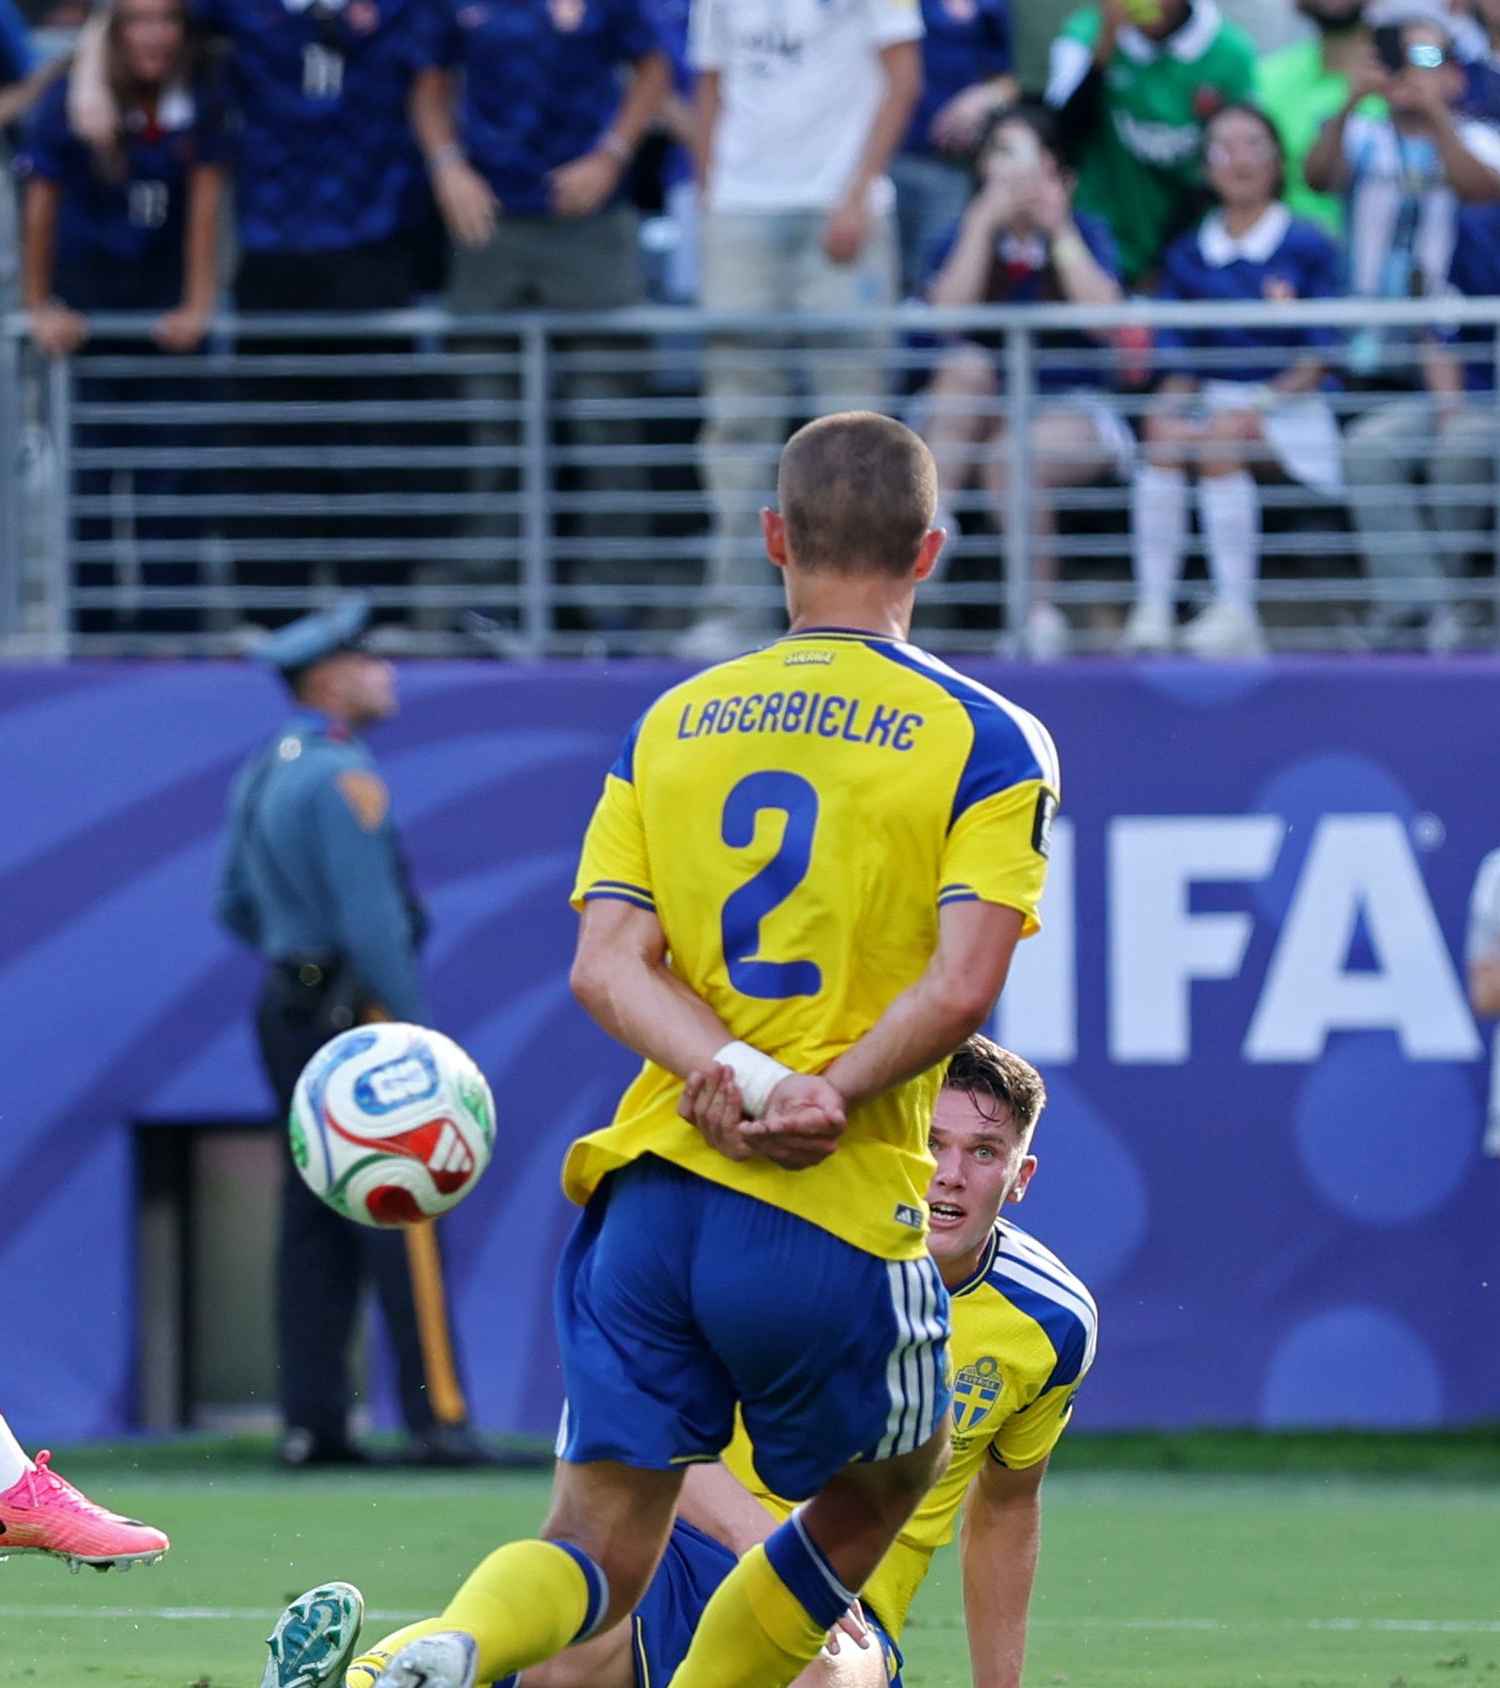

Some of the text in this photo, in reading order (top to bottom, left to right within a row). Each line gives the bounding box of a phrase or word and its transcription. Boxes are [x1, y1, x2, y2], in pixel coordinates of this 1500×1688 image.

[677, 690, 924, 752] LAGERBIELKE
[721, 770, 822, 999] 2
[993, 812, 1485, 1063] IFA
